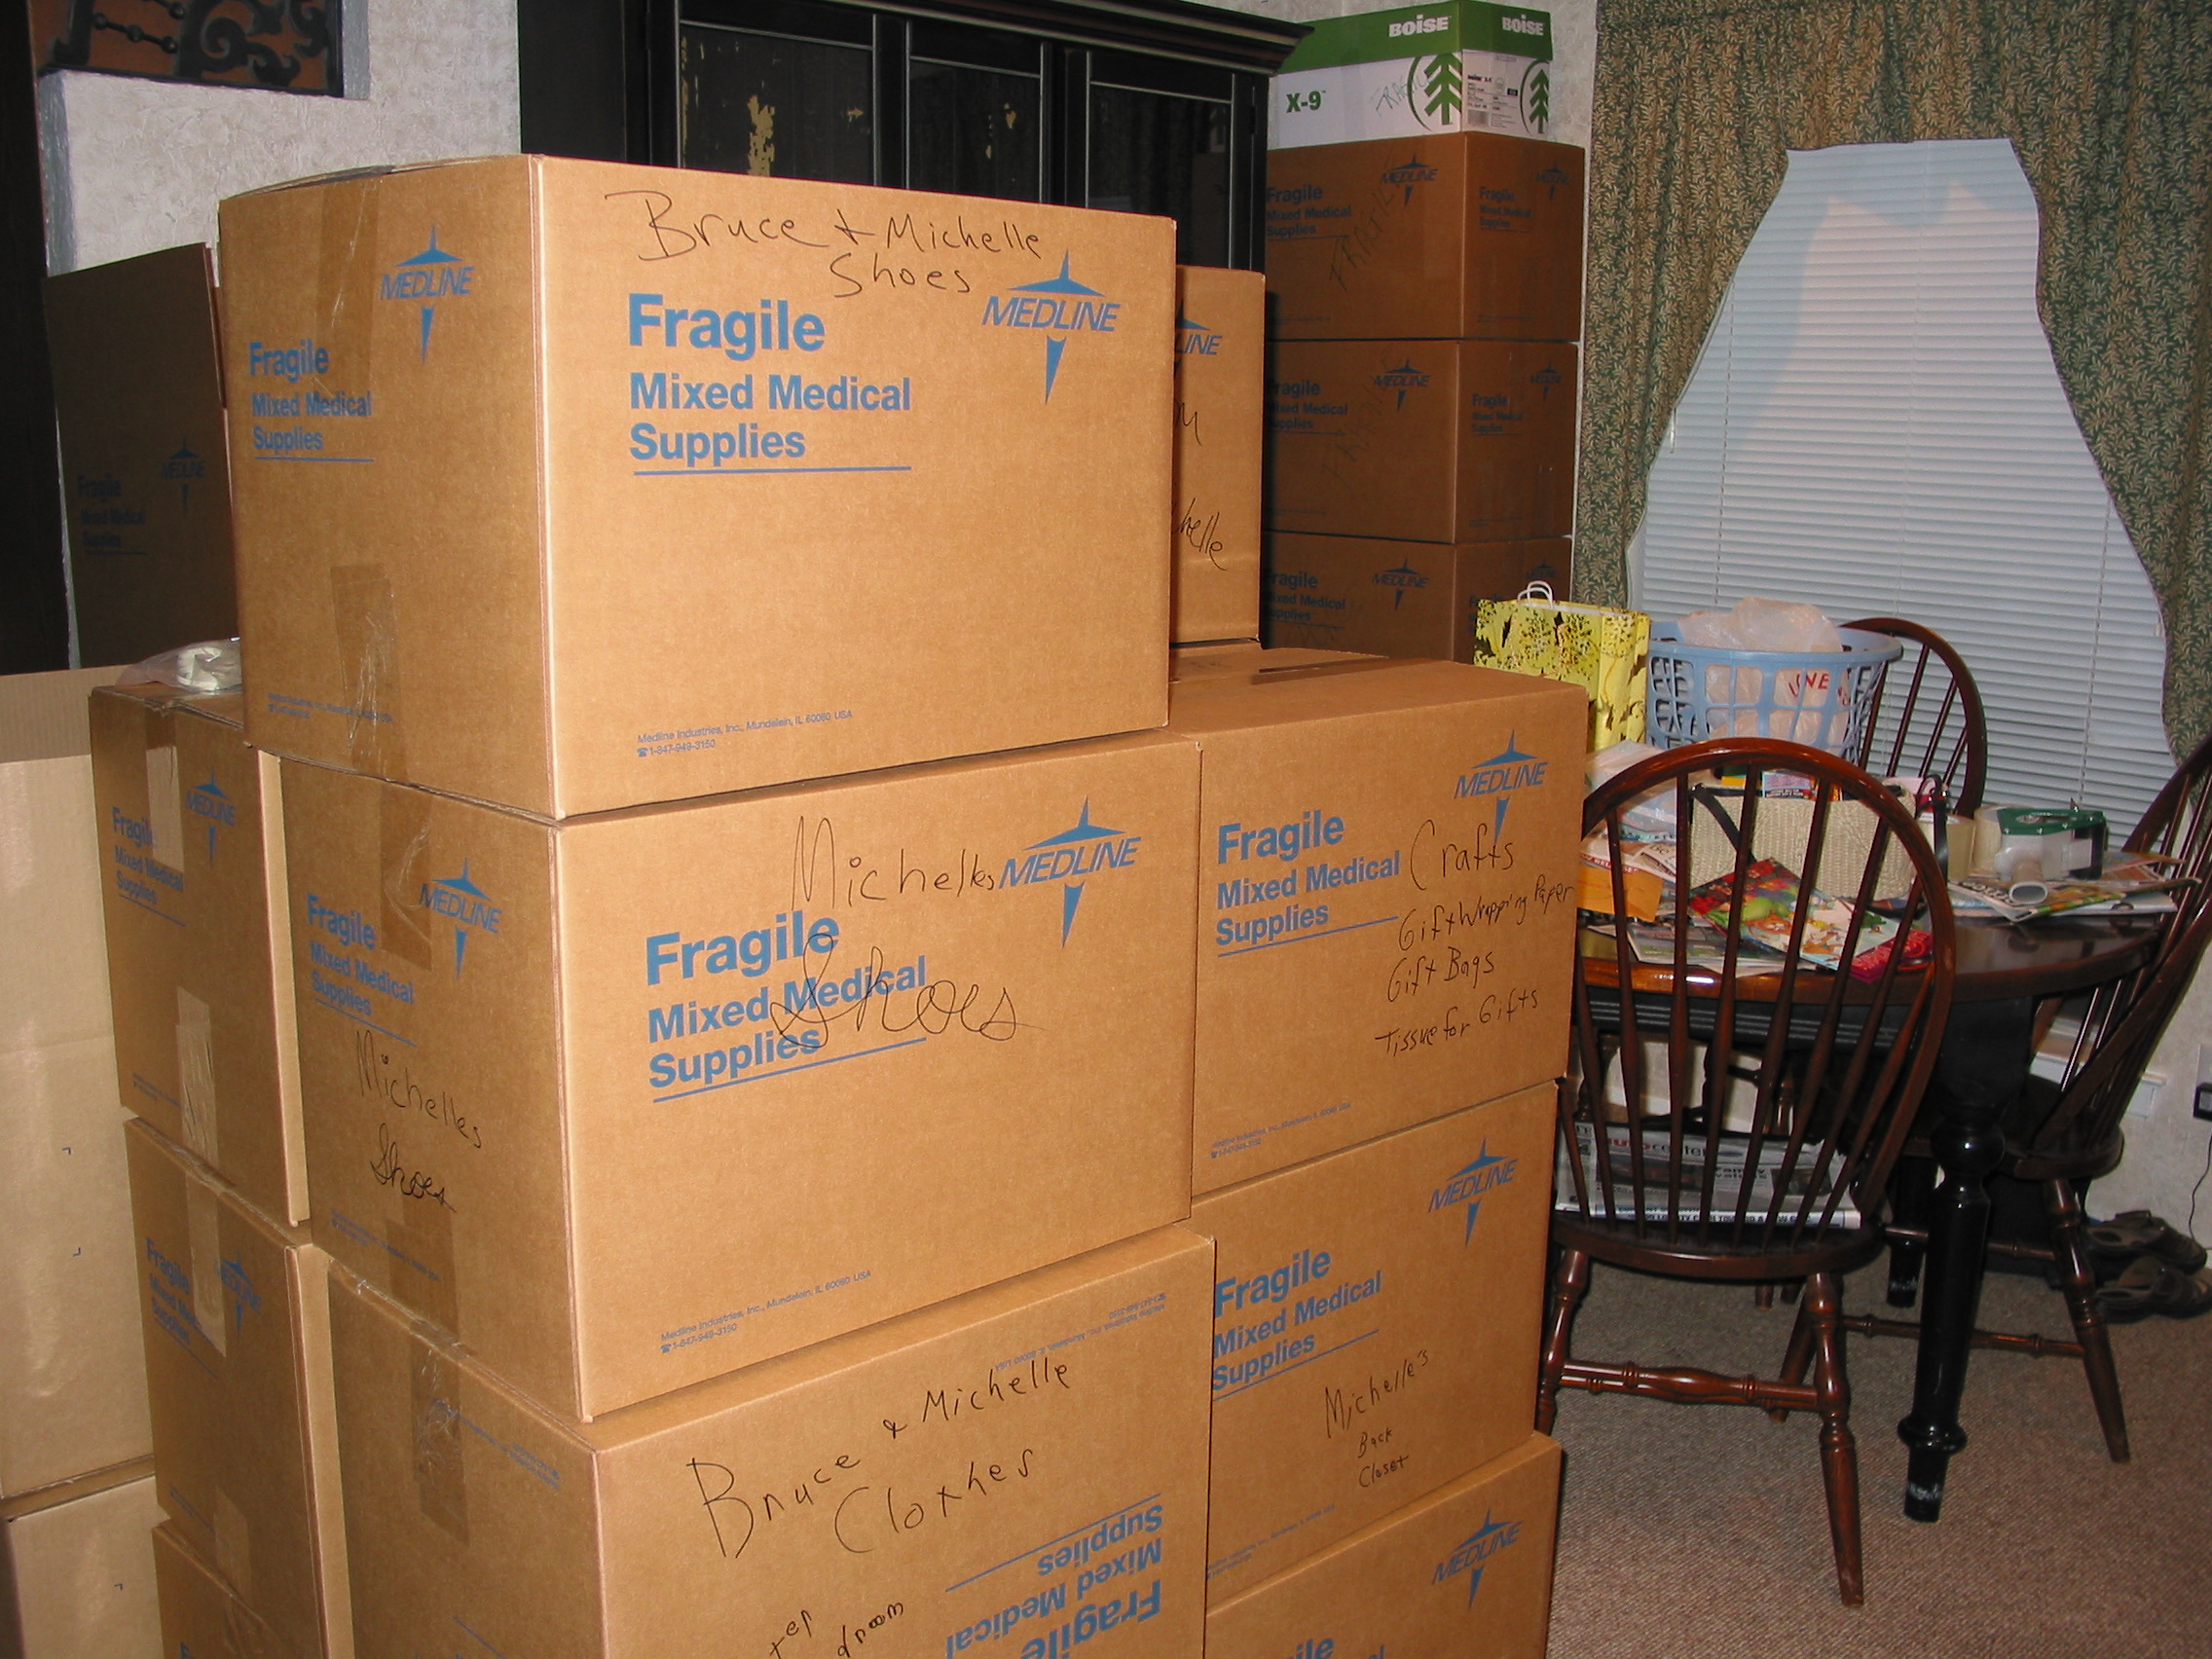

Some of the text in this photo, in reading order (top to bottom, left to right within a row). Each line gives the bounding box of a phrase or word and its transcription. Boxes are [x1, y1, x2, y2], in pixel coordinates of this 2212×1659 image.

[1267, 184, 1323, 203] Fragile
[1382, 168, 1438, 183] MEDLINE
[606, 190, 830, 261] Bruce
[886, 216, 1041, 260] Michelle
[1306, 205, 1351, 220] Medical
[379, 265, 475, 301] MEDLINE
[830, 253, 972, 298] Shoes
[629, 293, 826, 361] Fragile
[981, 295, 1121, 333] MEDLINE
[249, 339, 329, 384] Fragile
[1175, 334, 1223, 355] LINE
[251, 390, 372, 418] Mixed Medical
[630, 372, 911, 412] Mixed Medical
[1374, 375, 1430, 387] MEDLINE
[1303, 402, 1347, 415] Medical
[252, 424, 324, 454] Supplies
[629, 422, 806, 468] Supplies
[1300, 595, 1346, 611] Medical
[1372, 572, 1429, 588] MEDLINE
[834, 709, 853, 720] USA
[1454, 761, 1549, 799] MEDLINE
[112, 806, 154, 848] Fragil
[185, 790, 238, 828] MEDLINE
[1217, 809, 1346, 865] Fragile
[1410, 819, 1515, 891] Crafts
[998, 836, 1142, 890] MEDLINE
[1217, 851, 1400, 910] Mixed Medical
[307, 892, 377, 950] Fragile
[419, 882, 502, 935] MEDLINE
[1215, 902, 1330, 946] Supplies
[1398, 904, 1456, 951] Gift
[1533, 873, 1575, 914] Paper
[645, 909, 841, 987] Fragile
[310, 940, 415, 1006] Mixed Medical
[312, 970, 372, 1016] Supplies
[1387, 945, 1495, 1003] Gift Bags
[647, 955, 927, 1044] Mixed Medical
[1375, 988, 1539, 1057] Tissue for Gifts
[648, 1028, 822, 1089] Supplies
[1427, 1159, 1519, 1214] MEDLINE
[146, 1236, 190, 1296] Fragile
[853, 1269, 872, 1281] USA
[1214, 1249, 1332, 1319] Fragile
[1213, 1309, 1287, 1359] Mixed
[1293, 1269, 1382, 1327] Medical
[1212, 1334, 1316, 1392] Supplies
[922, 1357, 1071, 1424] Michelle
[1356, 1425, 1393, 1458] Back
[1358, 1455, 1410, 1488] Closet
[833, 1449, 1034, 1554] Clothes
[1037, 1504, 1163, 1576] Supplies
[1431, 1520, 1523, 1586] MEDLINE
[945, 1537, 1162, 1659] Mixed Medical
